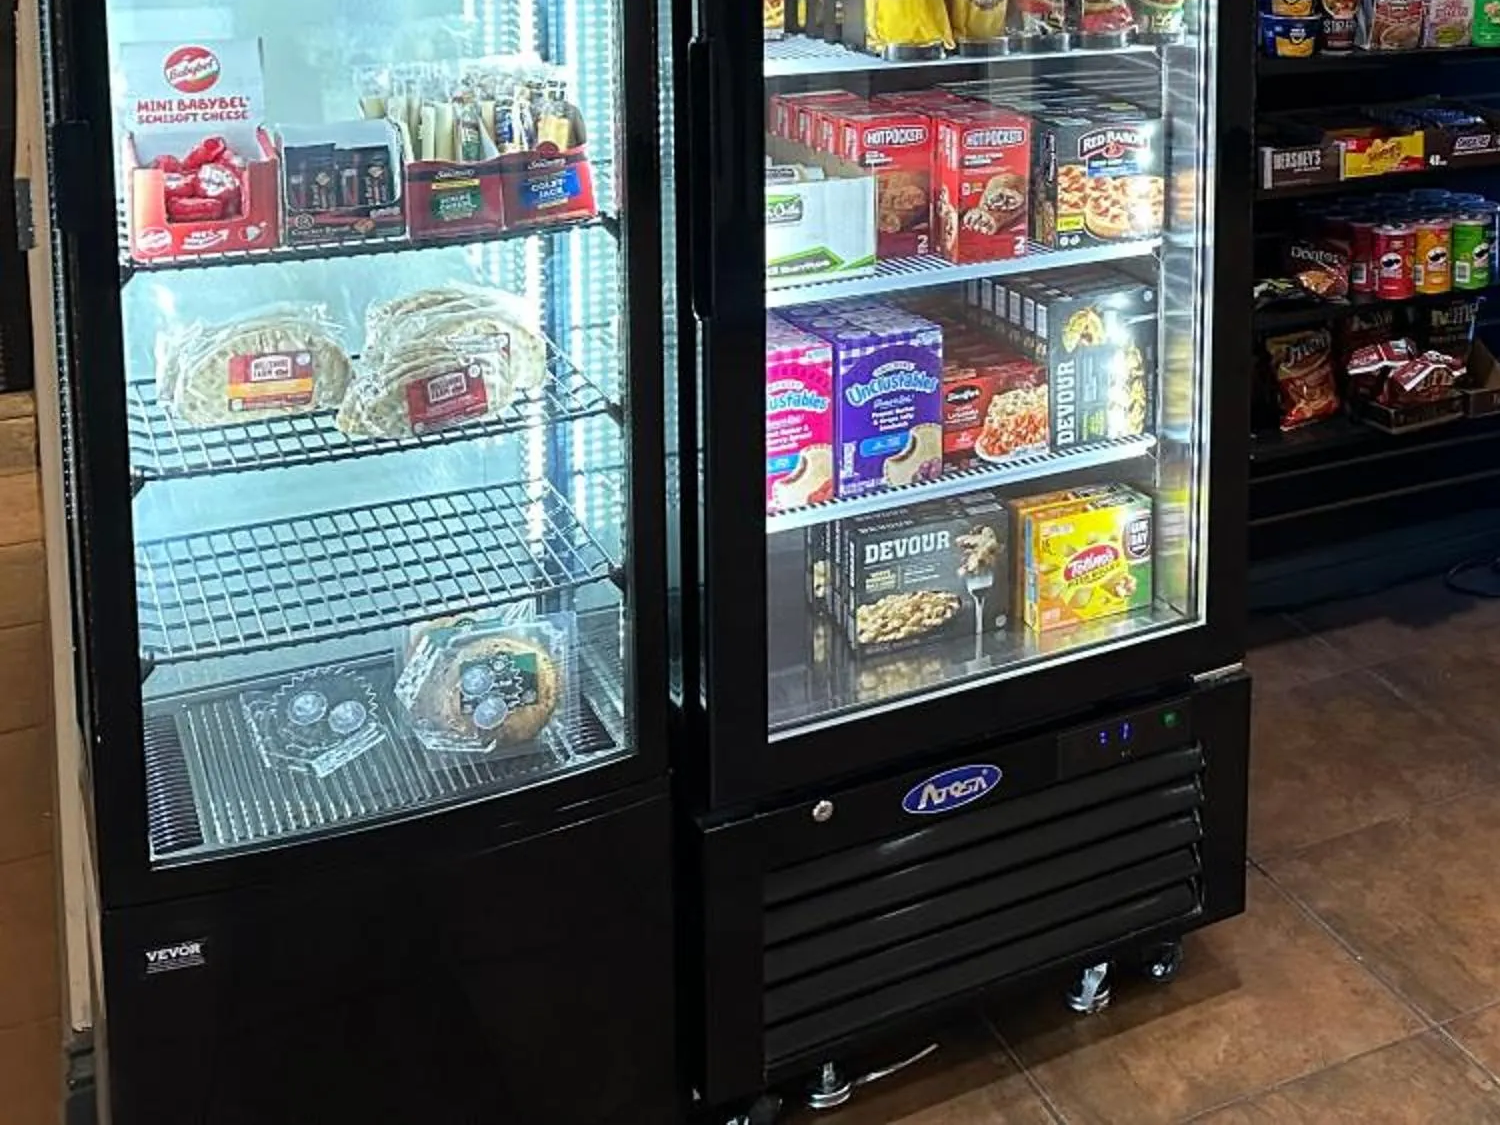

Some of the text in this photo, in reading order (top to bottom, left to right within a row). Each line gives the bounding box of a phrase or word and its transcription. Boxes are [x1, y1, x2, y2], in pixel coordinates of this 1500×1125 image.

[137, 96, 248, 113] MINI BABYBEL
[137, 110, 248, 124] SEMISOFT CHEESE
[1083, 132, 1105, 152] RED
[1273, 148, 1321, 170] HERSHEY'S
[1290, 246, 1340, 264] Doritos
[768, 393, 828, 411] ustables
[1056, 359, 1075, 446] DEVOUR
[865, 530, 951, 564] DEVOUR
[145, 941, 202, 963] VEVOR
